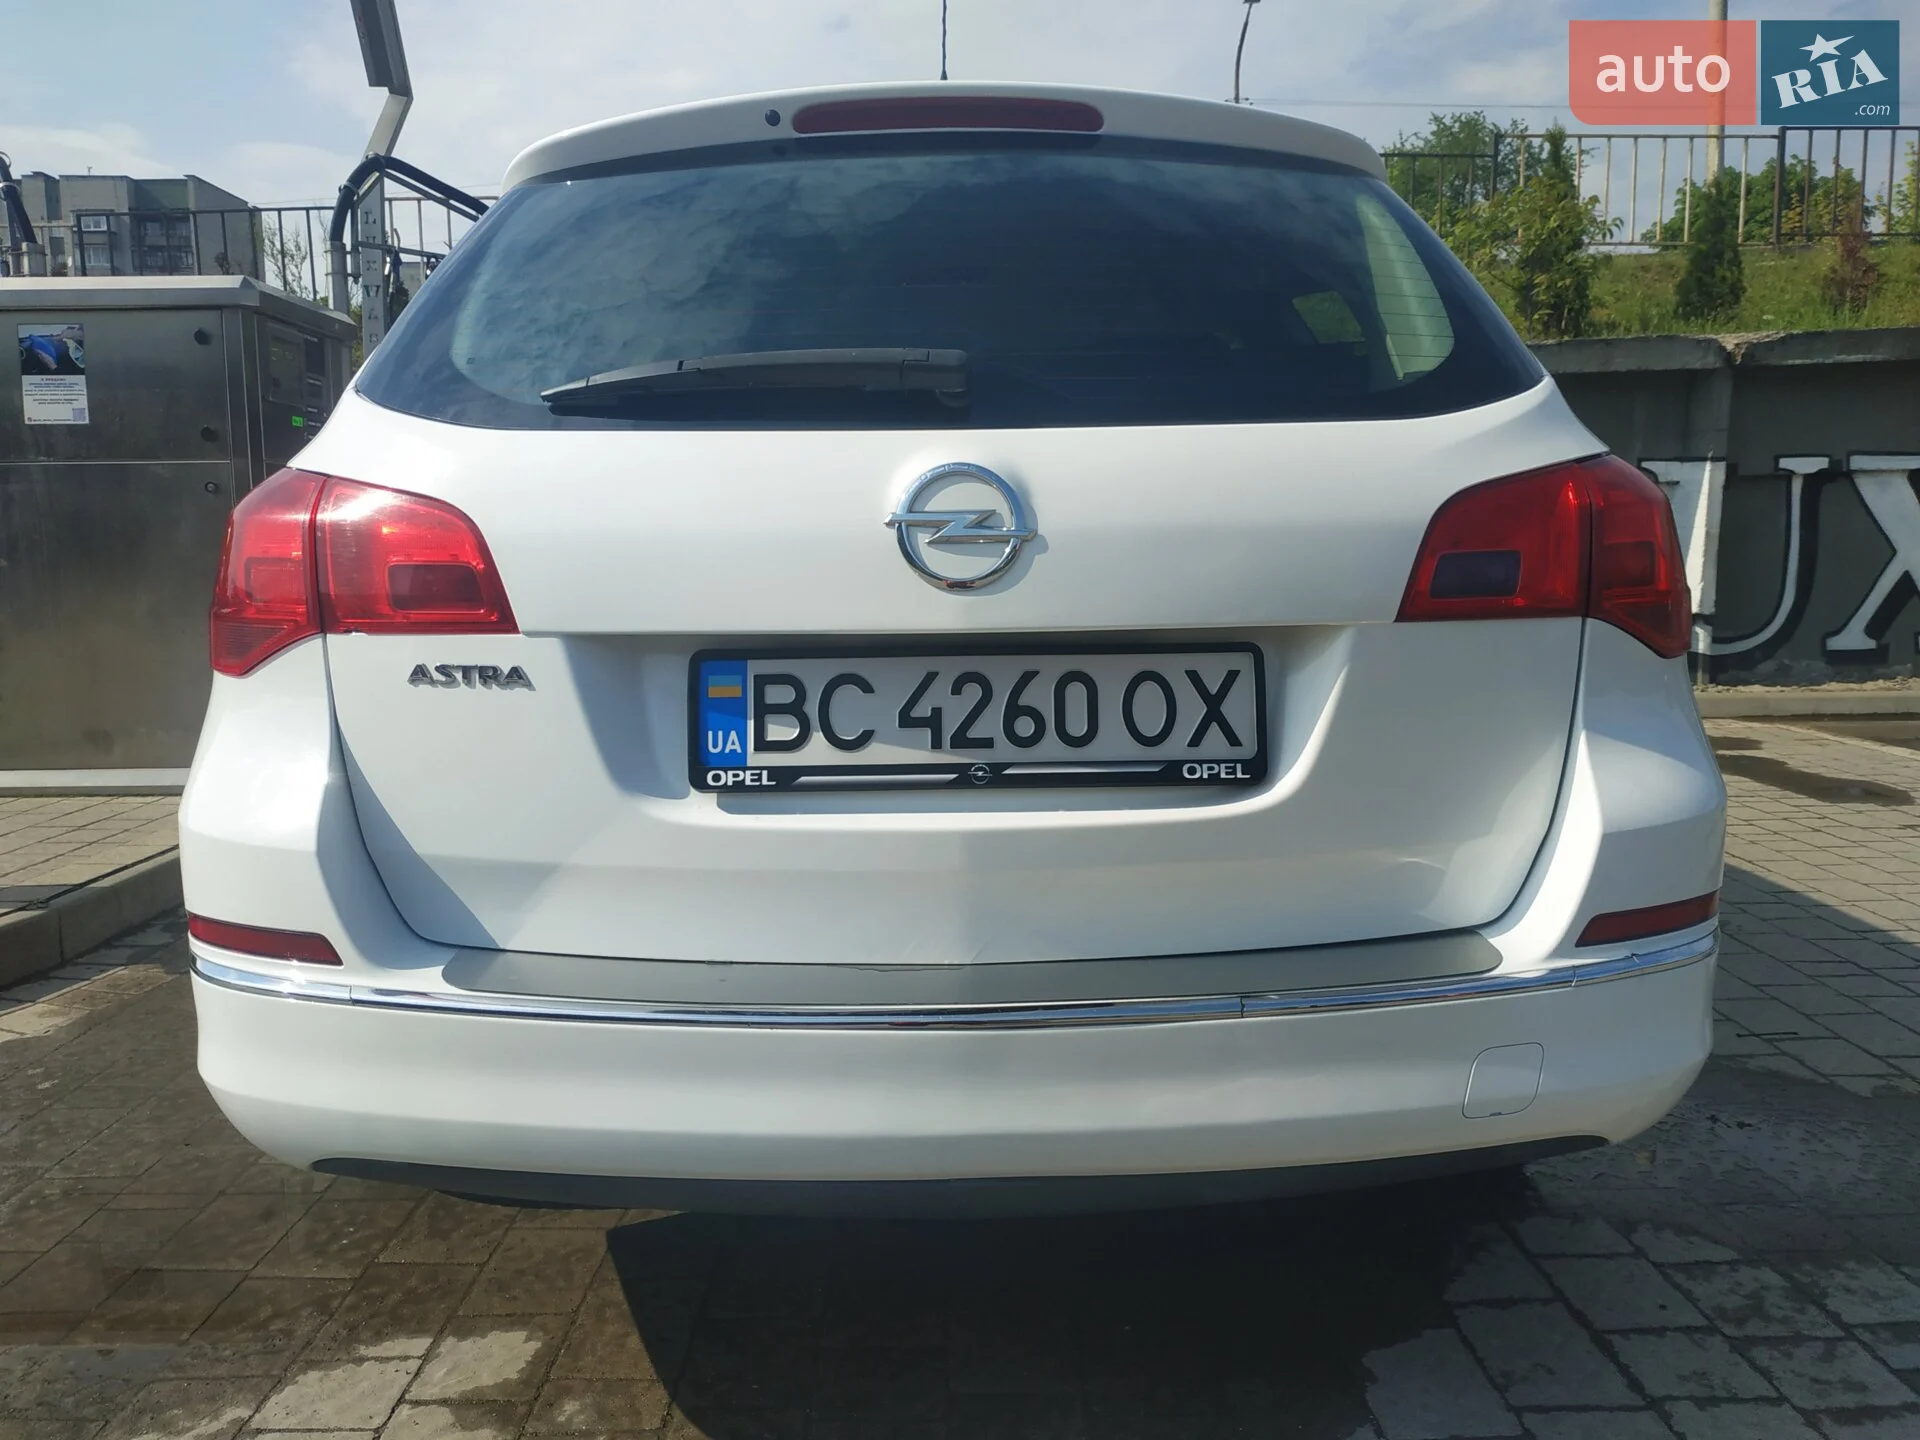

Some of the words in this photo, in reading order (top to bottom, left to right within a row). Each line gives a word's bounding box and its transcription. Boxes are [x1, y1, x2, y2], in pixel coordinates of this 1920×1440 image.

[407, 664, 536, 690] ASTRA
[753, 673, 875, 752] BC
[897, 670, 1099, 750] 4260
[1121, 669, 1243, 749] OX
[707, 730, 742, 754] UA
[706, 769, 777, 786] OPEL
[1182, 763, 1251, 779] OPEL
